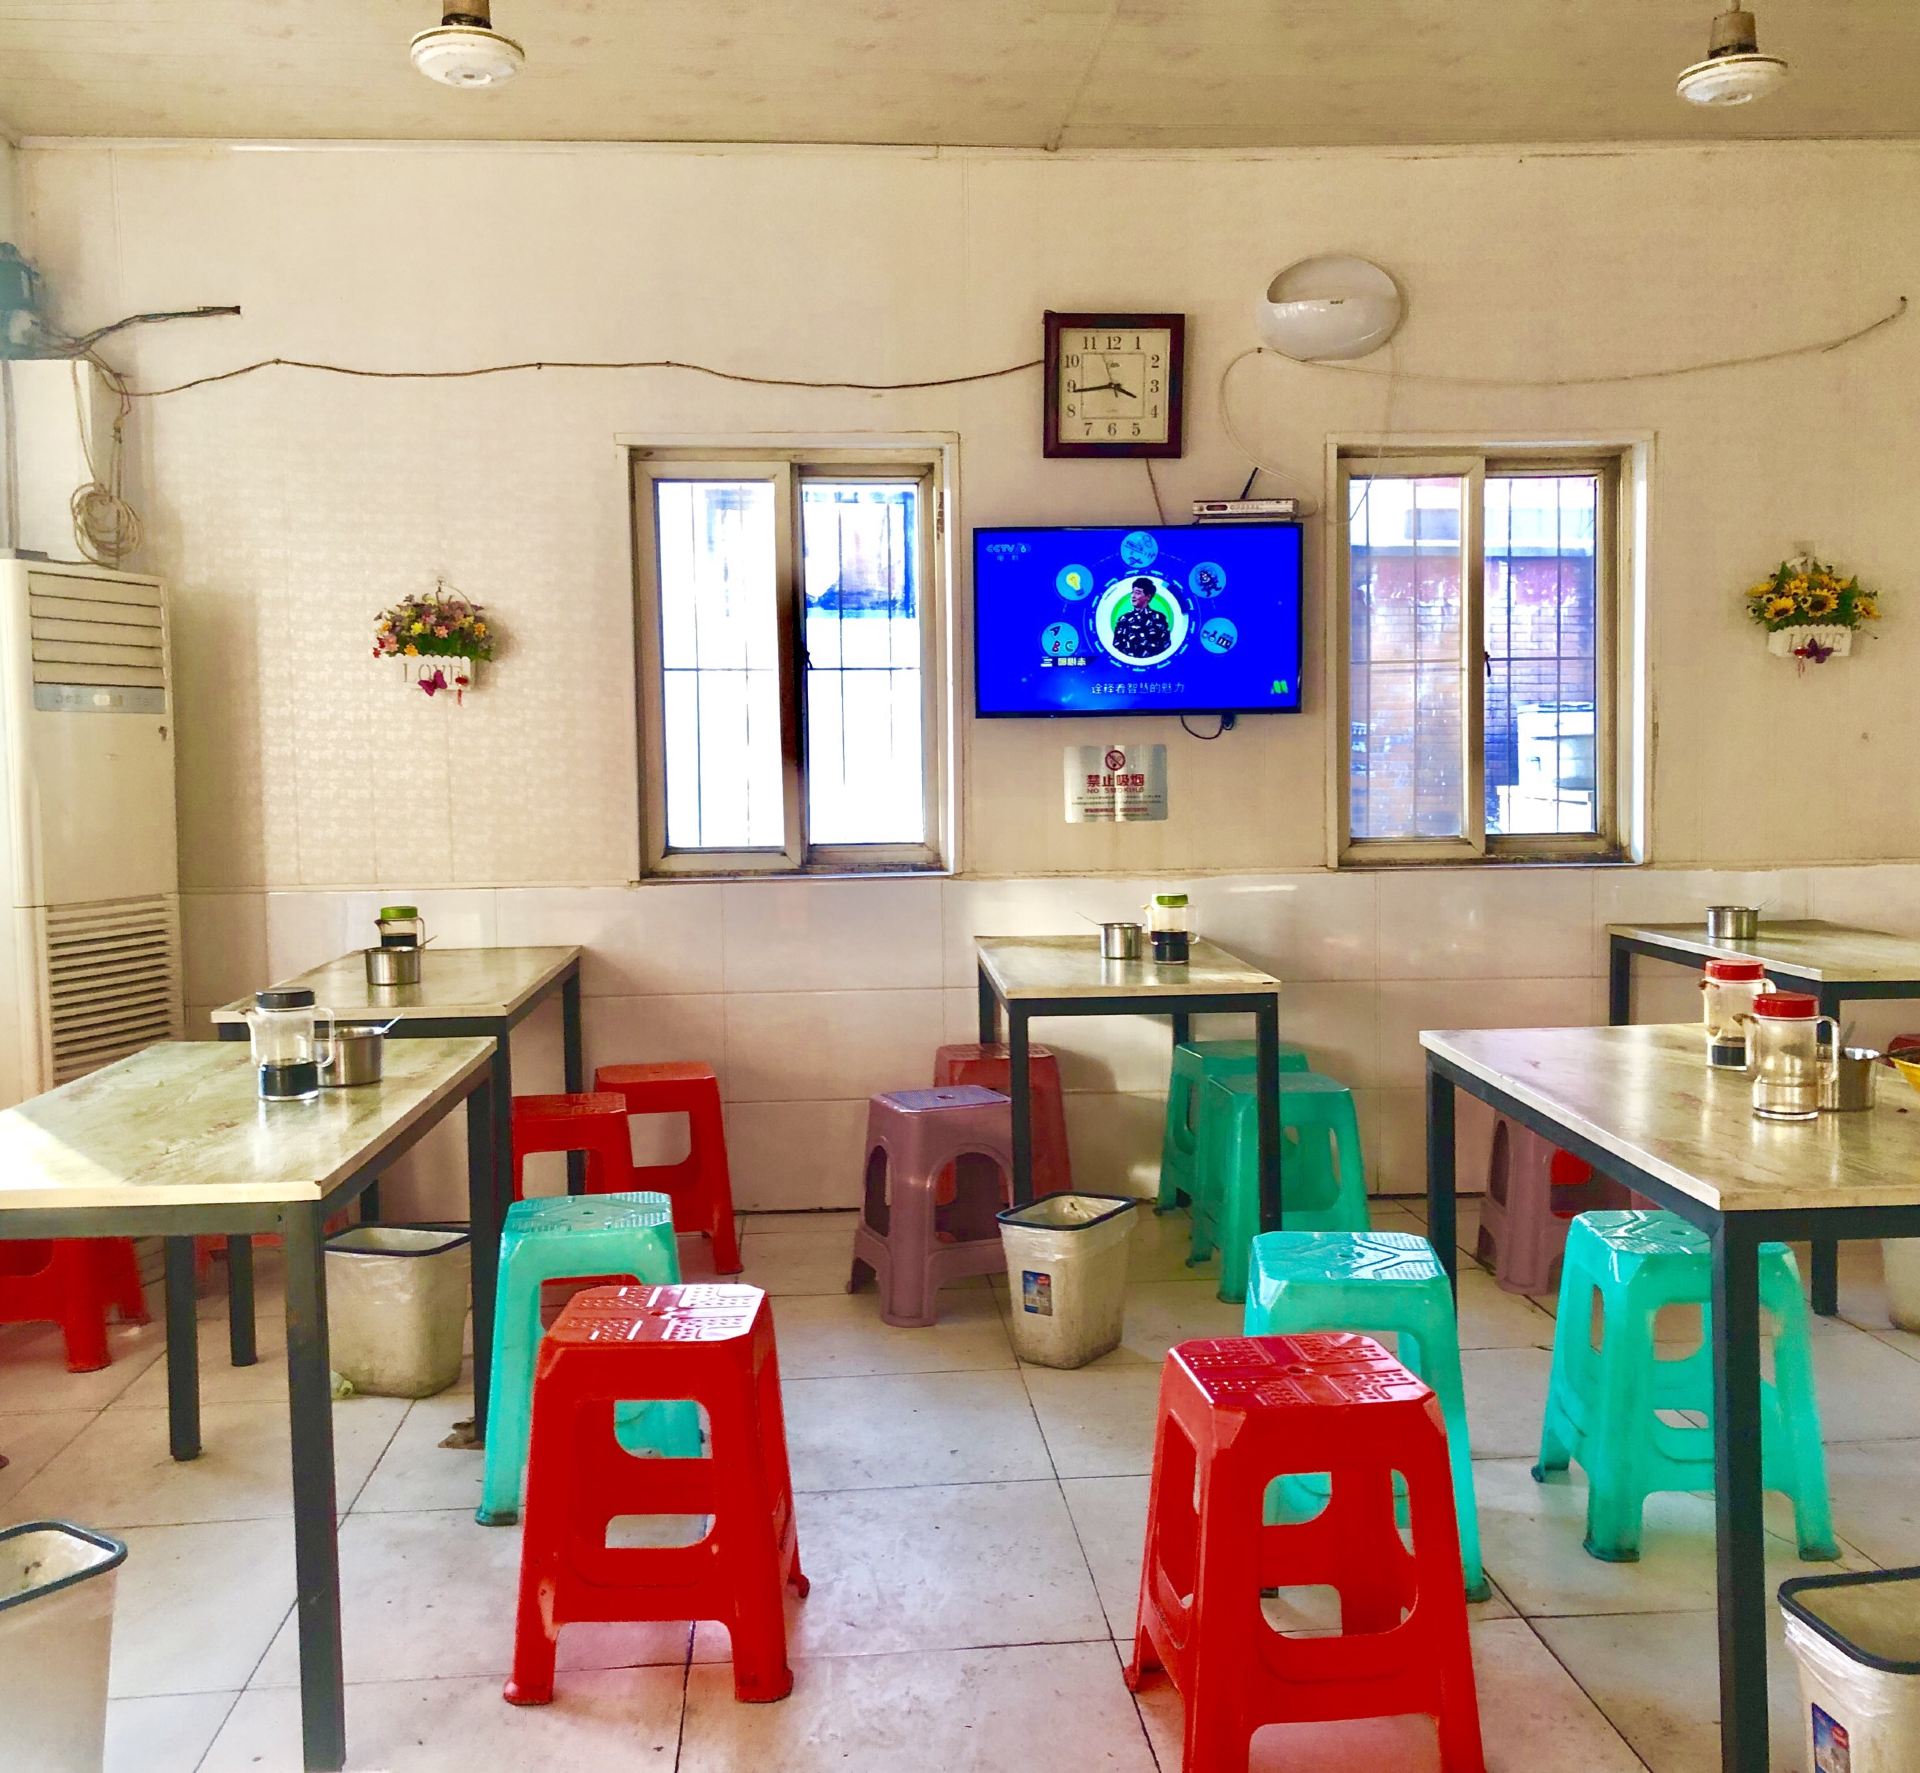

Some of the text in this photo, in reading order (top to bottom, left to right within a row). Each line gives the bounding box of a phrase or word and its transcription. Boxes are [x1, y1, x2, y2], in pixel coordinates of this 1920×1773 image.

[1083, 336, 1141, 350] 11 12 1
[1064, 354, 1080, 368] 10
[1151, 354, 1160, 368] 2
[1067, 380, 1077, 393] 9
[1150, 380, 1159, 393] 3
[1066, 404, 1076, 418] 8
[1150, 405, 1158, 418] 4
[1084, 422, 1141, 436] 7 6 5
[985, 544, 1015, 553] CCTV
[1087, 774, 1145, 787] 禁止吸烟
